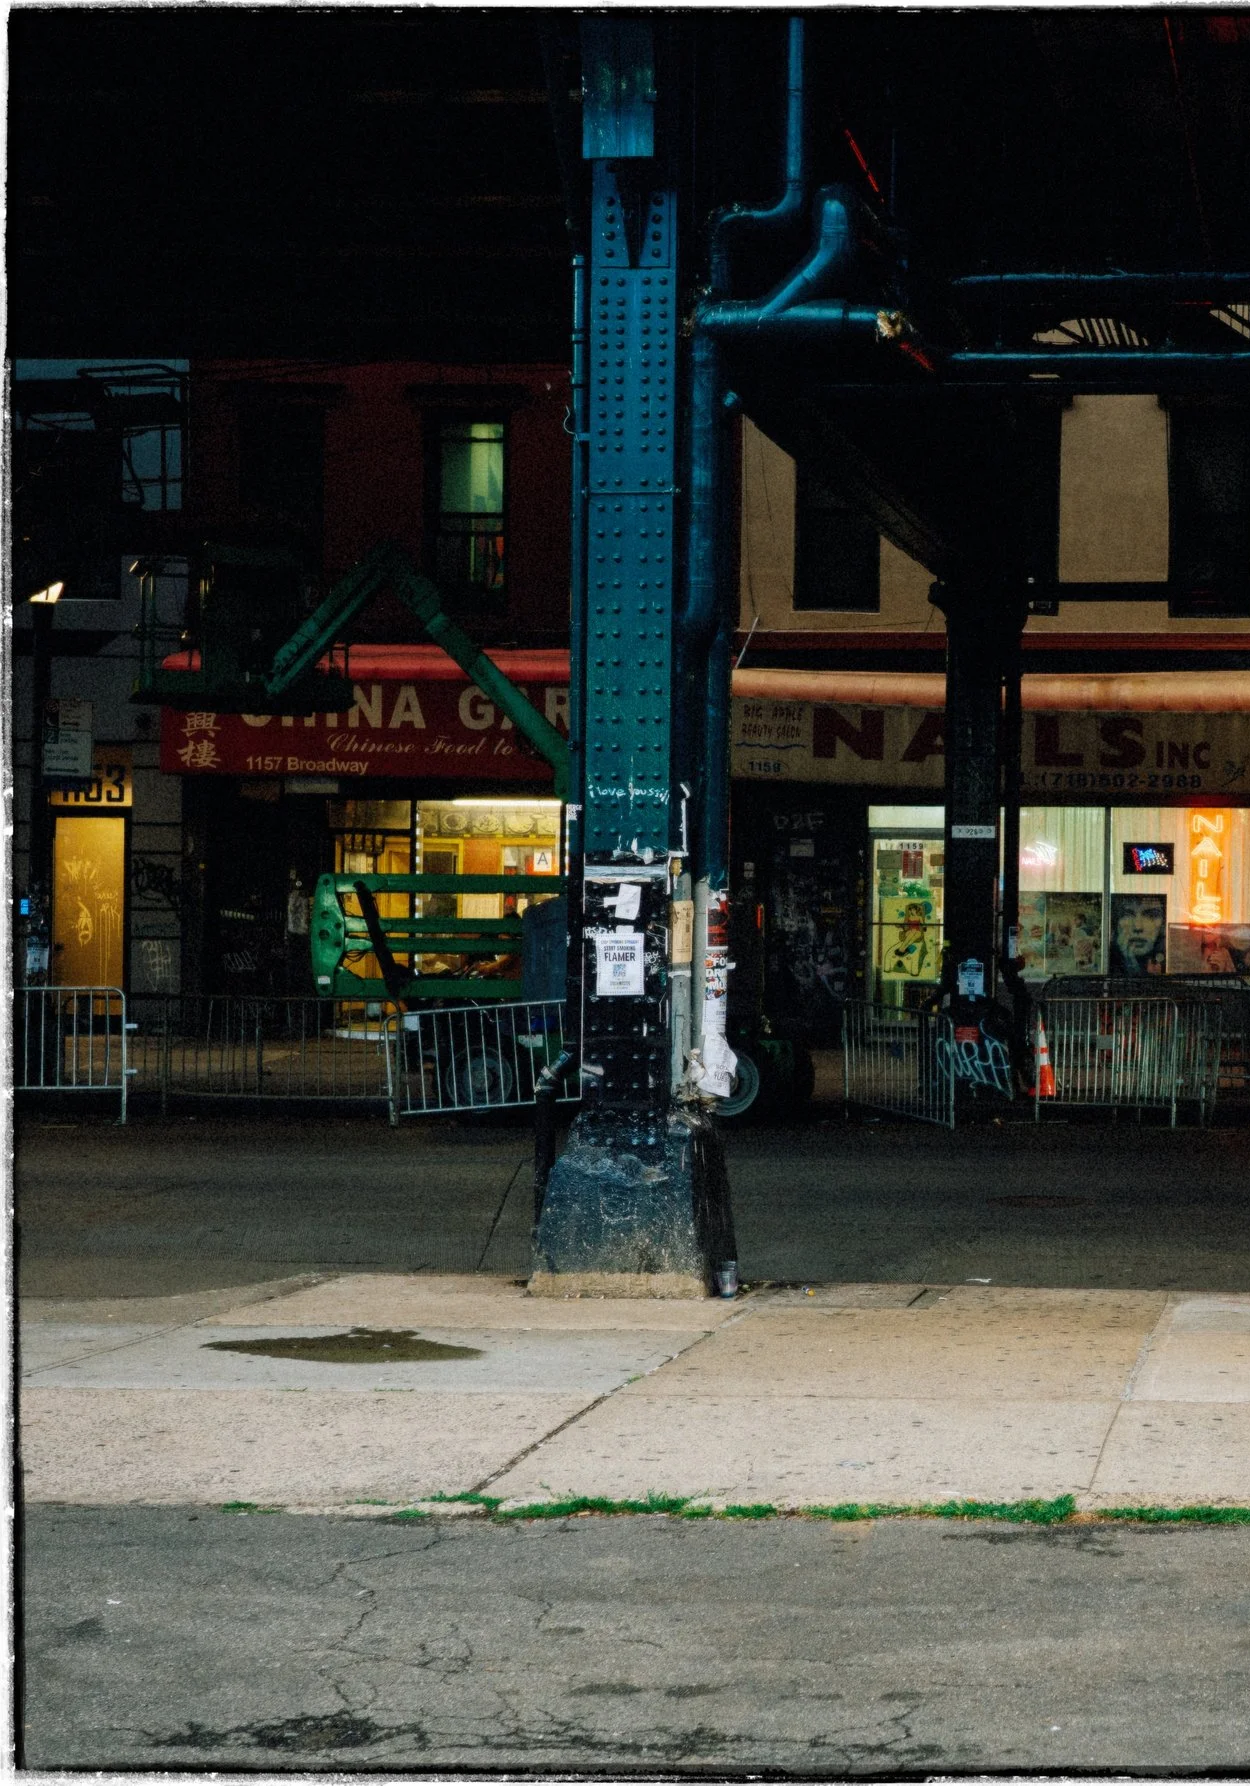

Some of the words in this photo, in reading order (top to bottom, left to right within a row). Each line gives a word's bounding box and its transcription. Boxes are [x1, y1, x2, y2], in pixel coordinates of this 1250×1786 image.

[176, 712, 222, 769] 興樓
[326, 733, 416, 753] Chinese
[424, 735, 488, 756] Food
[813, 703, 1146, 769] NALS
[246, 756, 283, 771] 1157
[287, 756, 369, 775] Broadway
[1155, 741, 1210, 769] INC
[537, 851, 549, 865] A
[604, 952, 636, 962] FLAMER
